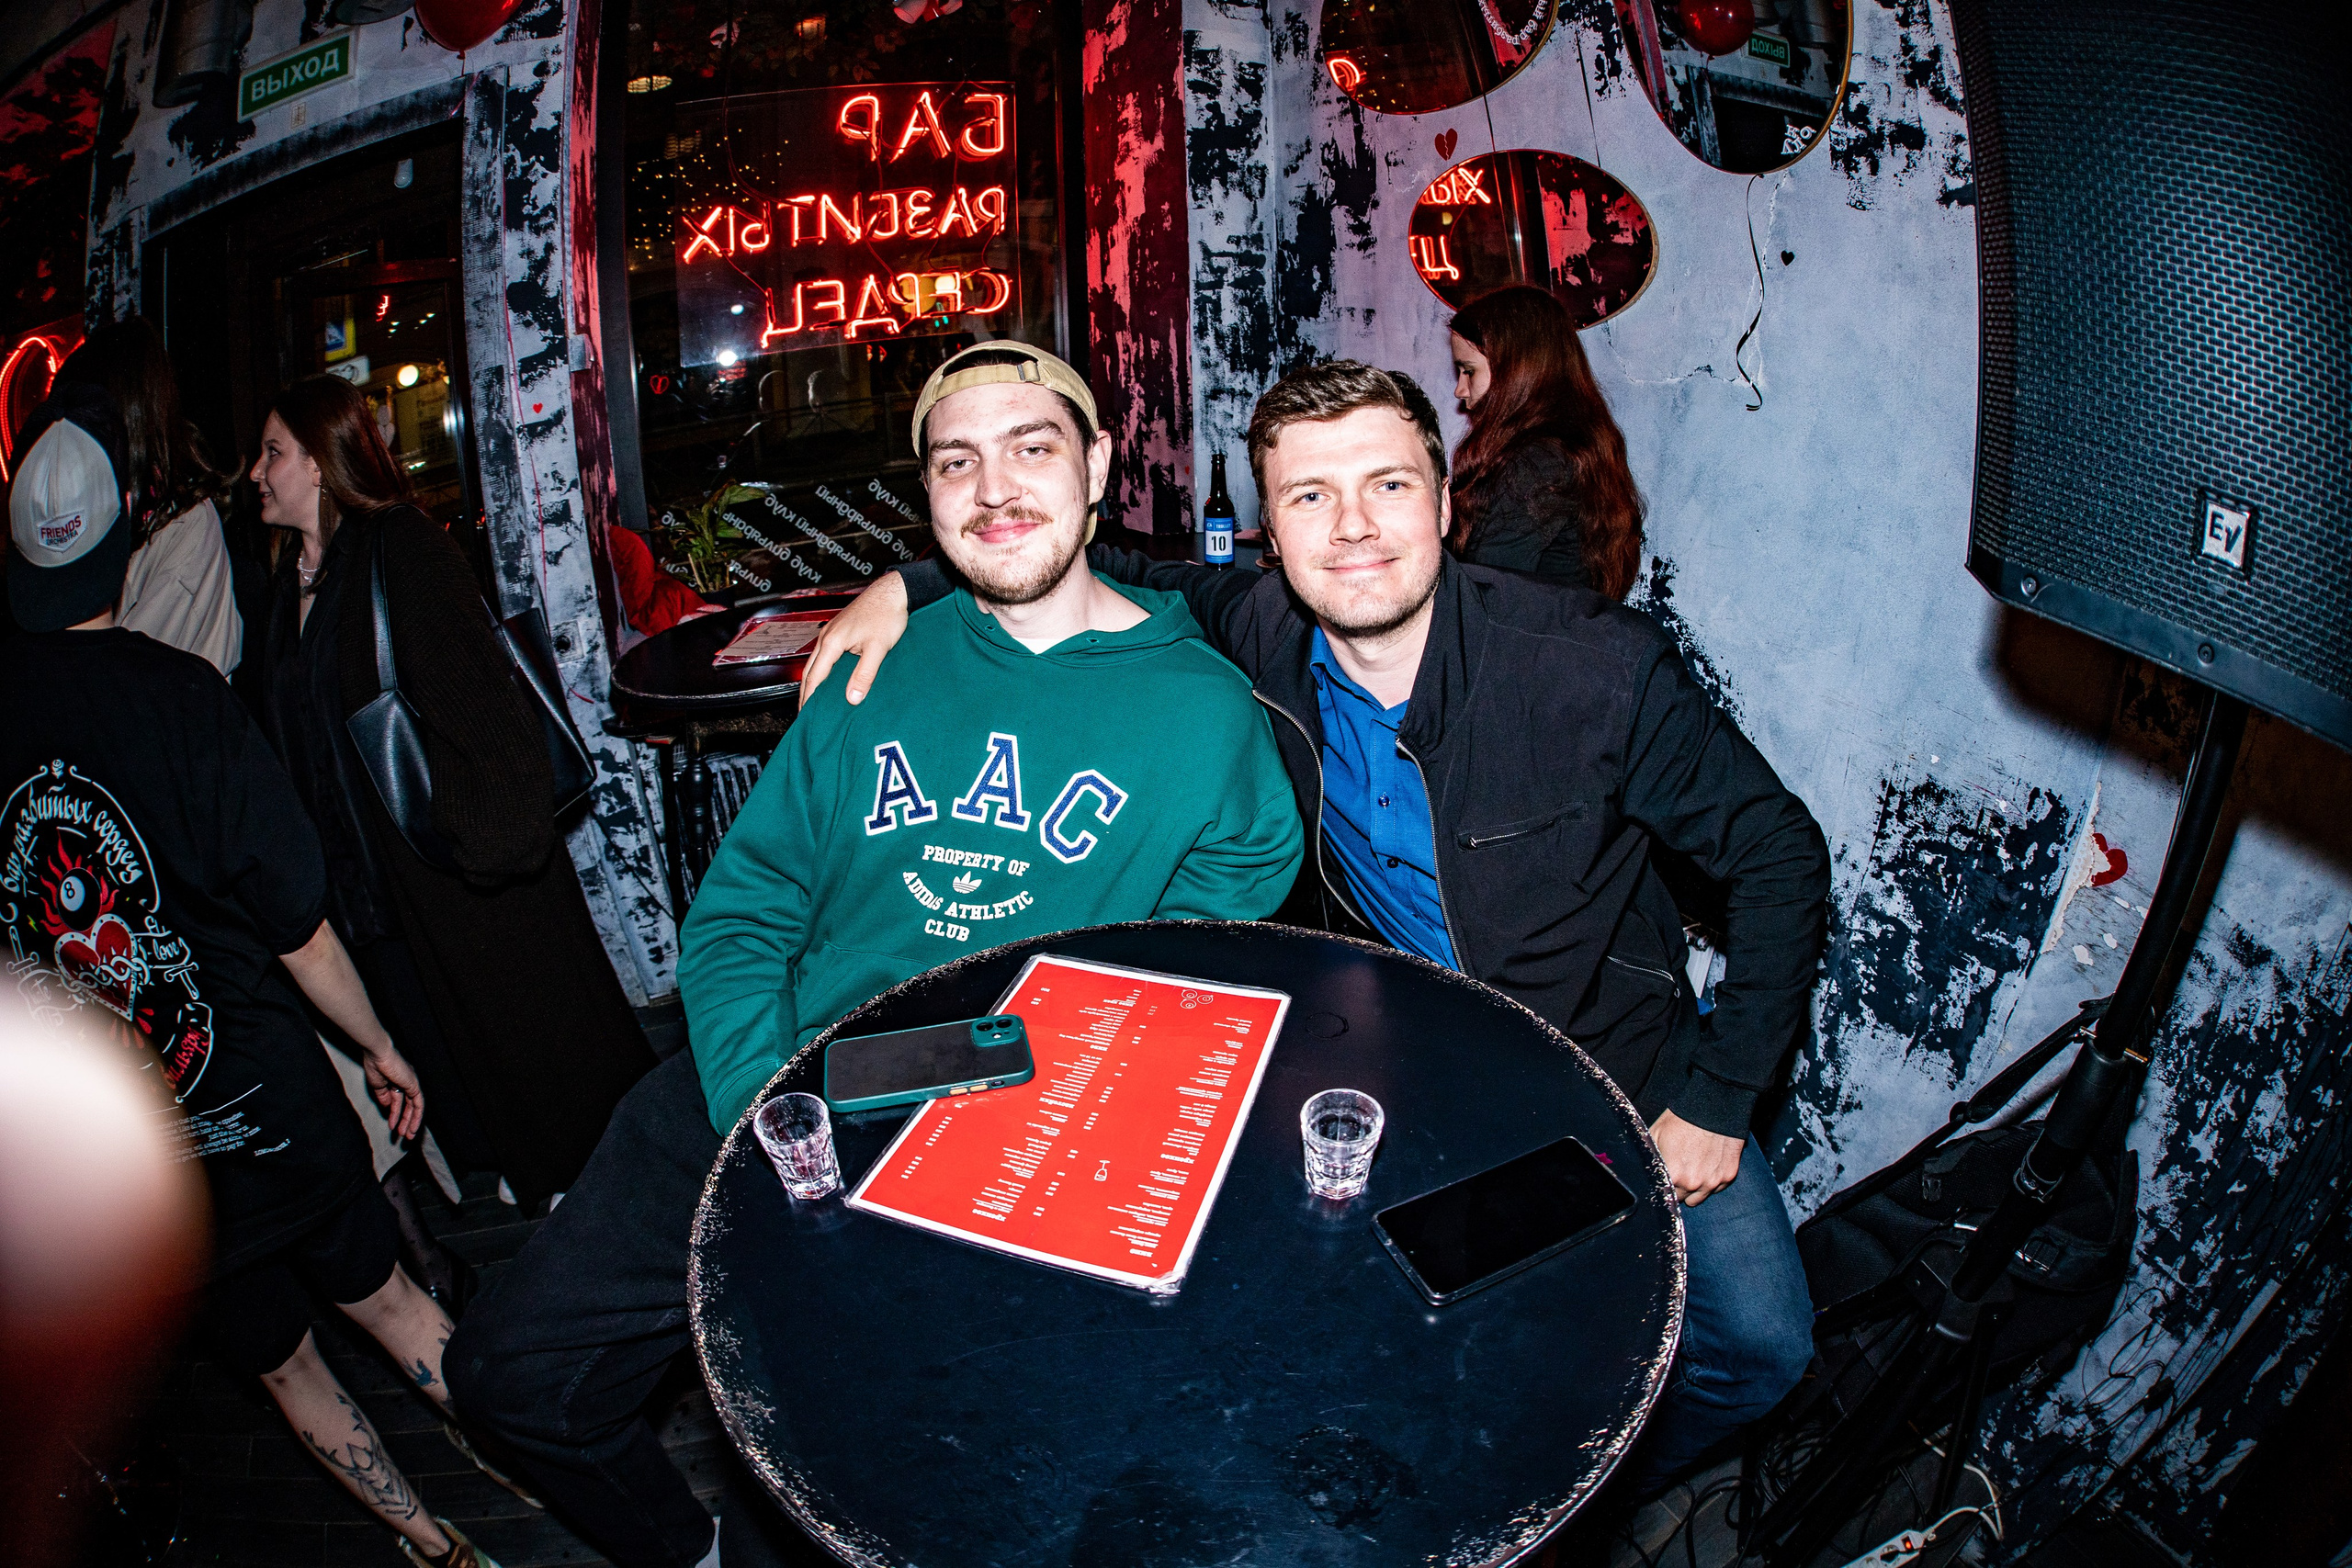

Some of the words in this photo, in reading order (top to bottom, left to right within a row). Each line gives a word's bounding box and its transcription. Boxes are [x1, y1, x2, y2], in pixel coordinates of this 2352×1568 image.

[252, 48, 340, 102] ВЫХОД
[1410, 235, 1459, 280] Ц
[40, 515, 82, 539] FRIENDS
[46, 530, 79, 546] ORCHESTRA
[2209, 511, 2243, 553] EV
[1212, 536, 1226, 551] 10
[864, 731, 1129, 864] AAC
[93, 810, 143, 885] сердец
[922, 844, 1005, 872] PROPERTY
[1007, 859, 1031, 877] OF
[63, 881, 76, 899] 8
[944, 890, 1035, 920] ATHLETIC
[924, 919, 970, 942] CLUB
